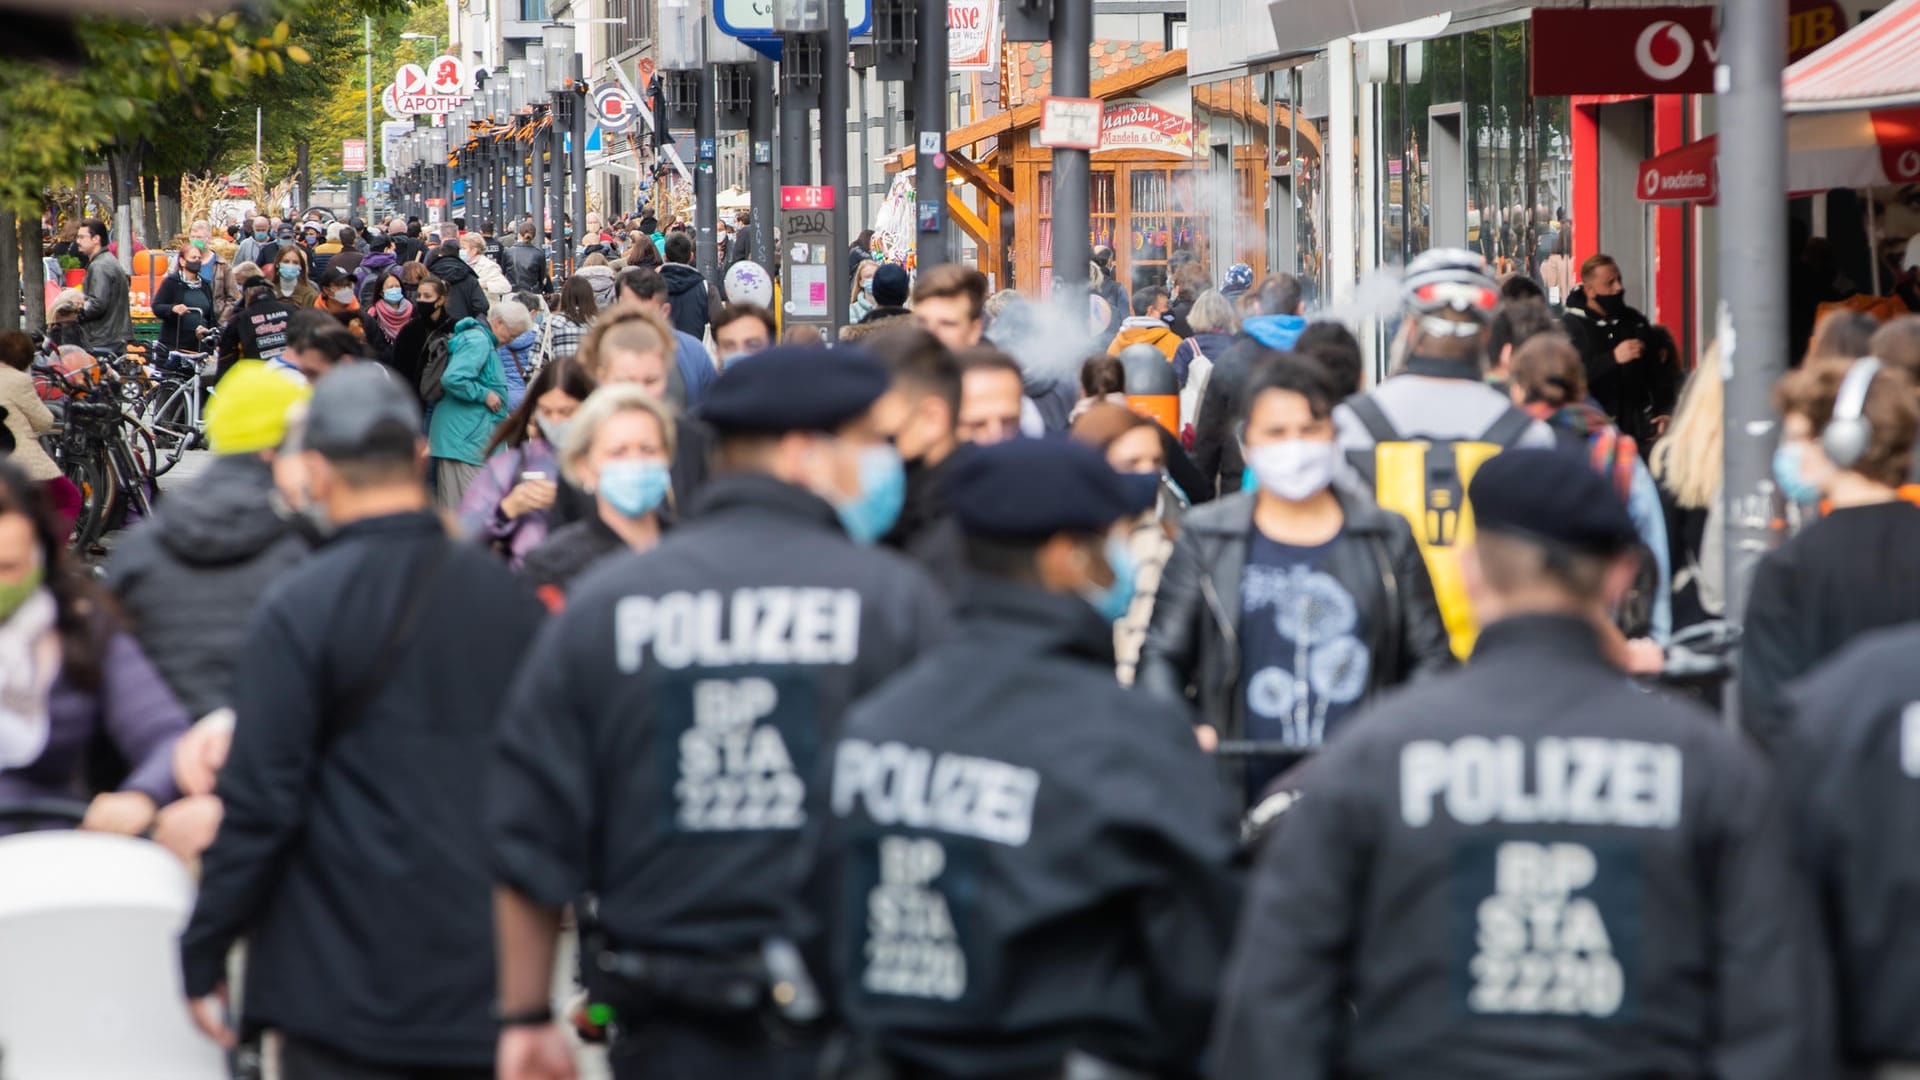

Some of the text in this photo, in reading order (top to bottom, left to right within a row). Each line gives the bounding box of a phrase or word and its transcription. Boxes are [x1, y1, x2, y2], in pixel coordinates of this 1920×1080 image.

[1103, 131, 1139, 145] Mandeln
[1141, 134, 1148, 144] &
[1661, 169, 1706, 189] vodafone
[615, 586, 861, 673] POLIZEI
[693, 678, 778, 728] BP
[677, 725, 796, 779] STA
[673, 774, 807, 830] 2222
[831, 738, 1040, 847] POLIZEI
[1401, 735, 1683, 829] POLIZEI
[879, 834, 946, 886] BP
[1495, 841, 1597, 898] BP
[867, 883, 958, 939] STA
[1475, 896, 1613, 955] STA
[1467, 951, 1625, 1018] 2220
